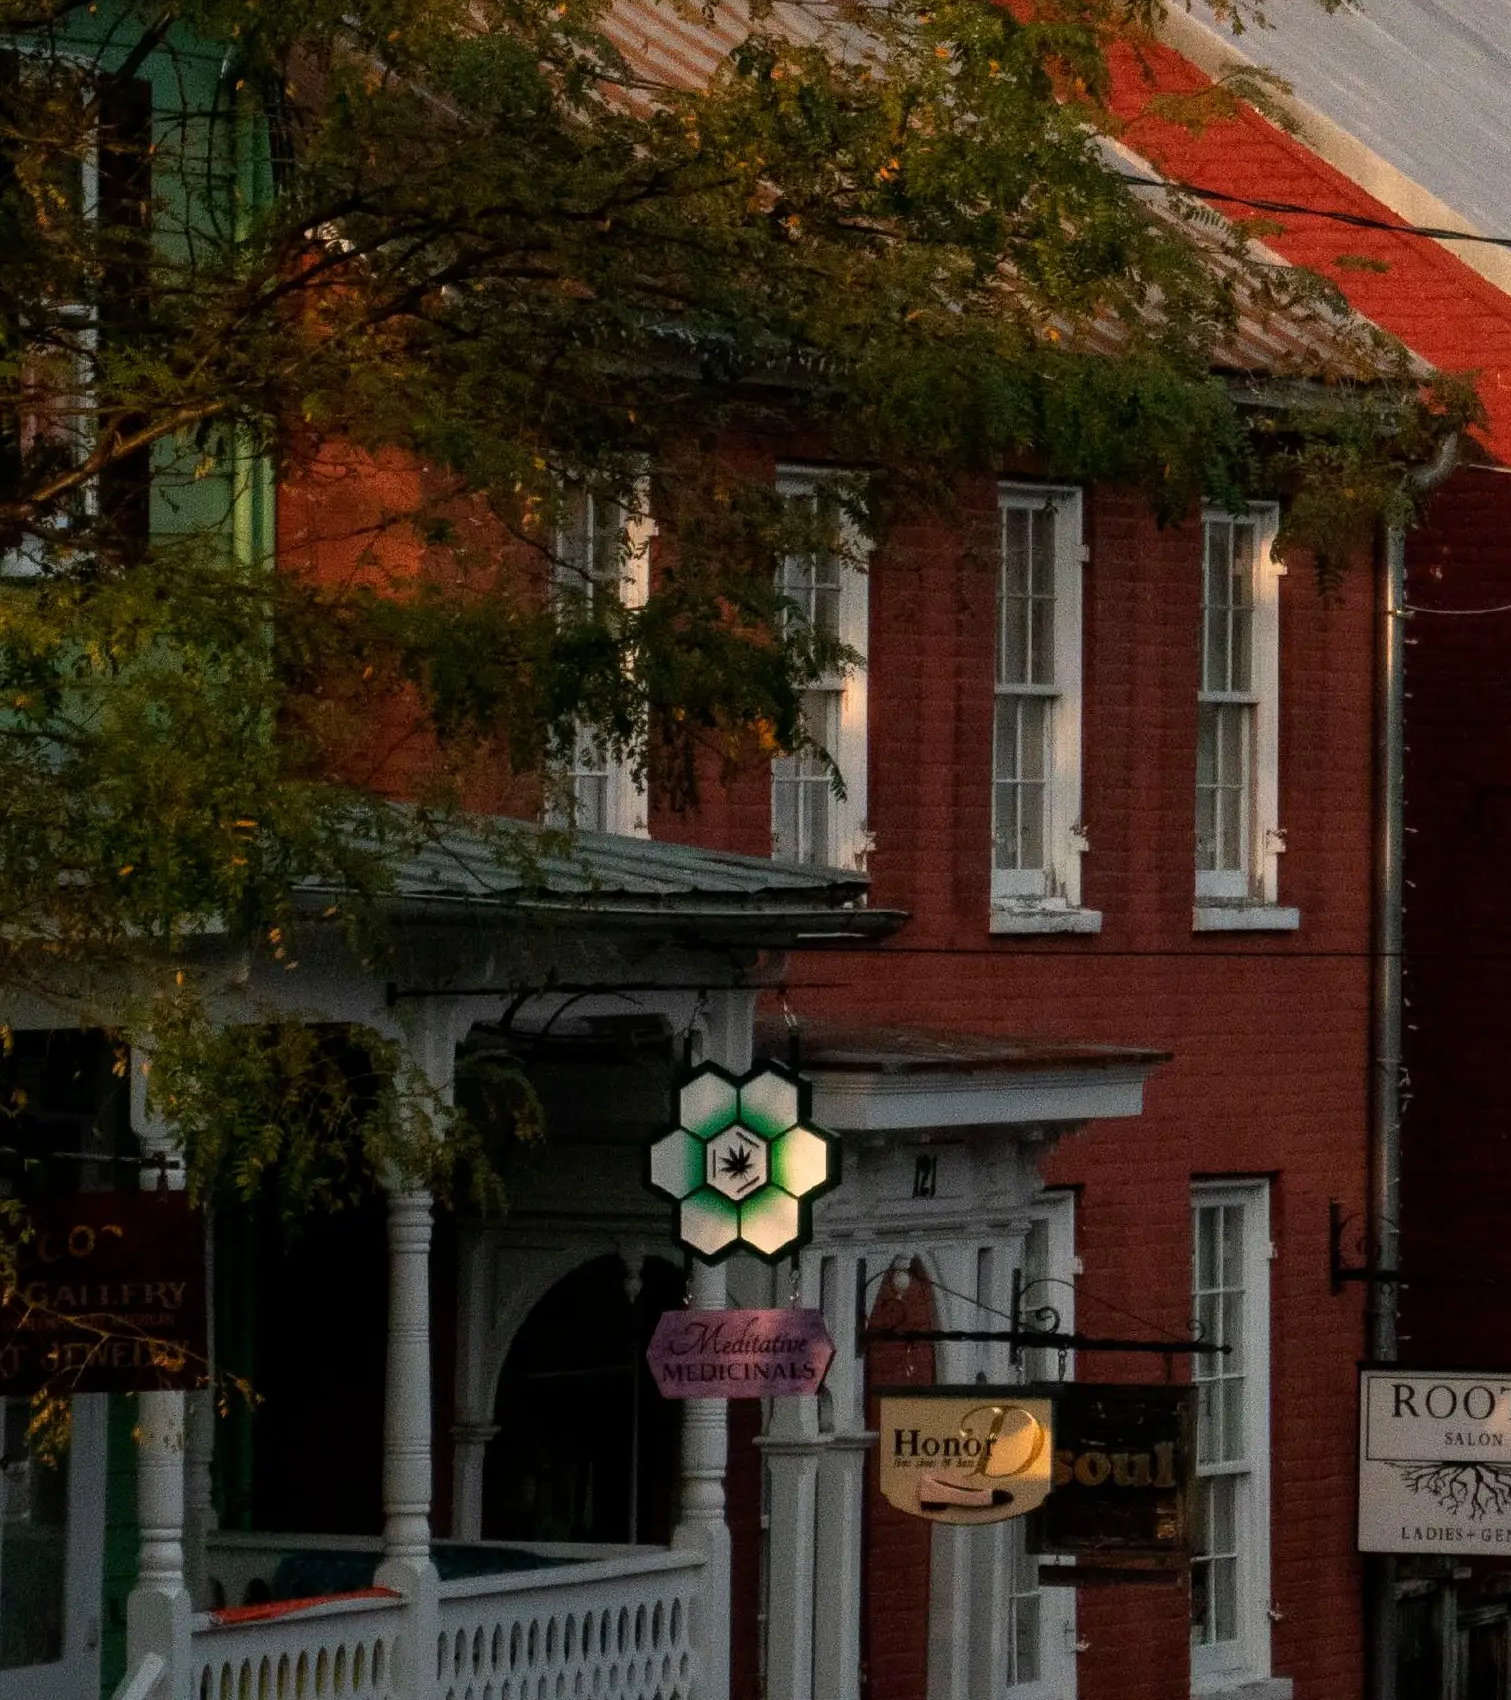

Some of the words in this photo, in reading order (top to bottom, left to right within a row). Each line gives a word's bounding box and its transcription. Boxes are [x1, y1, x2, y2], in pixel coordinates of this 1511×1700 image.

[669, 1316, 809, 1356] Meditative
[663, 1363, 815, 1382] MEDICINALS
[893, 1429, 998, 1457] Honor
[1444, 1432, 1504, 1447] SALON
